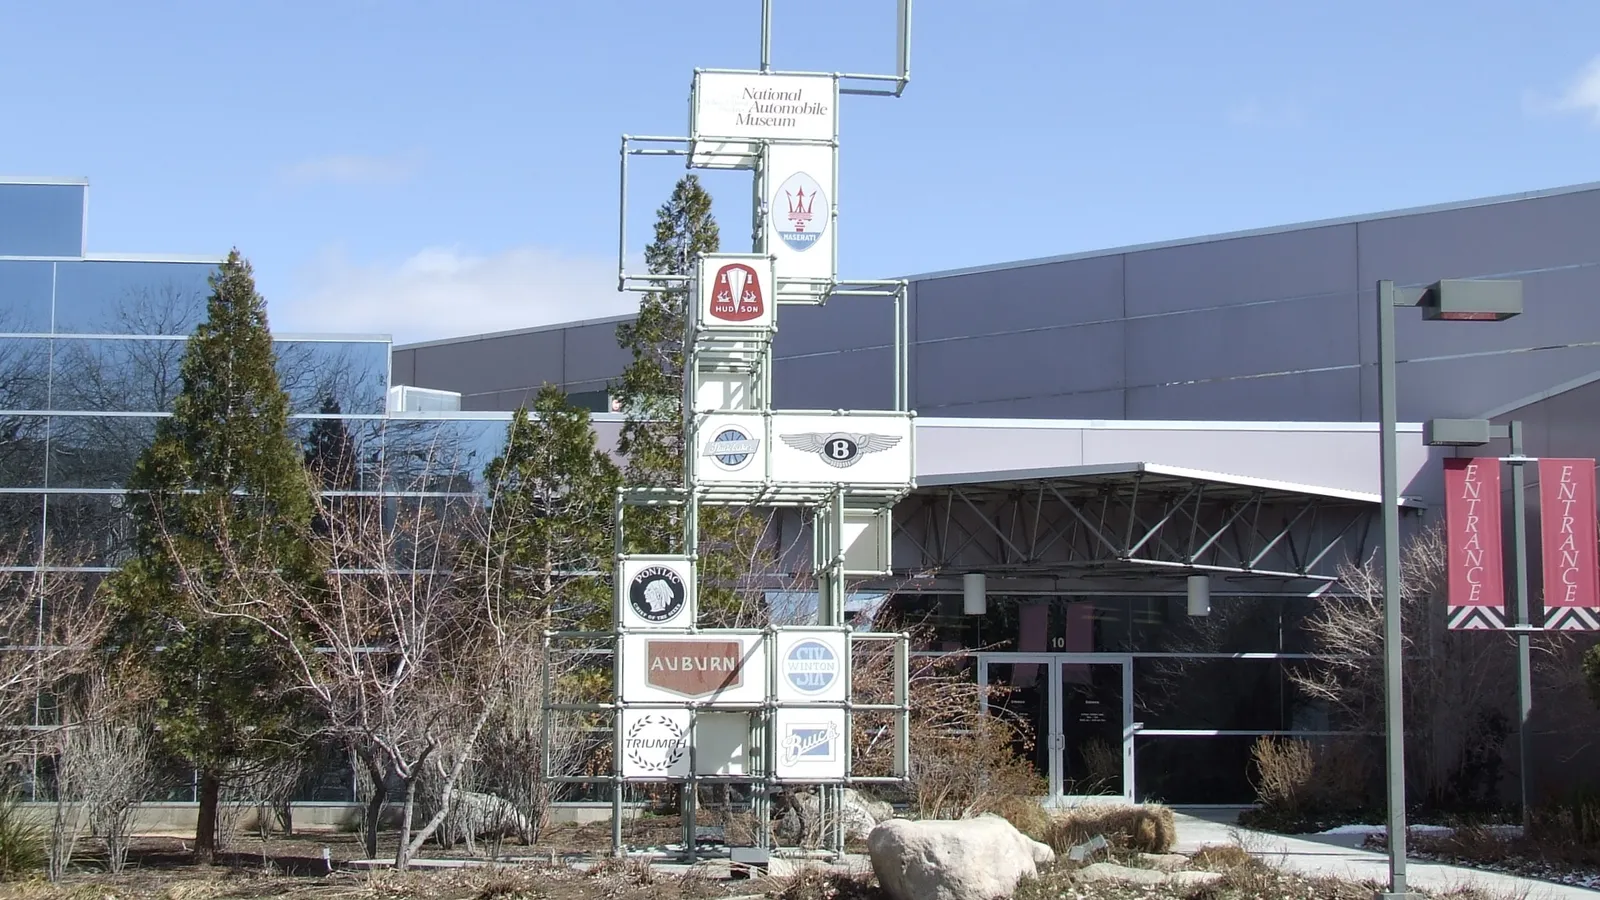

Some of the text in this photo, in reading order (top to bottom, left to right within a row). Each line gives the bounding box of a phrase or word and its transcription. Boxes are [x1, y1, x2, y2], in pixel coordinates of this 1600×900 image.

[742, 87, 802, 101] National
[749, 101, 828, 116] Automobile
[735, 112, 796, 127] Museum
[783, 233, 817, 242] MASERATI
[715, 305, 759, 313] HUDSON
[833, 442, 849, 459] B
[1461, 465, 1484, 601] ENTRANCE
[1557, 466, 1580, 602] ENTRANCE
[635, 567, 680, 584] PONTIAC
[1051, 637, 1065, 648] 10
[651, 656, 735, 671] AUBURN
[787, 662, 835, 671] WINTON
[626, 738, 687, 749] TRIUMPH
